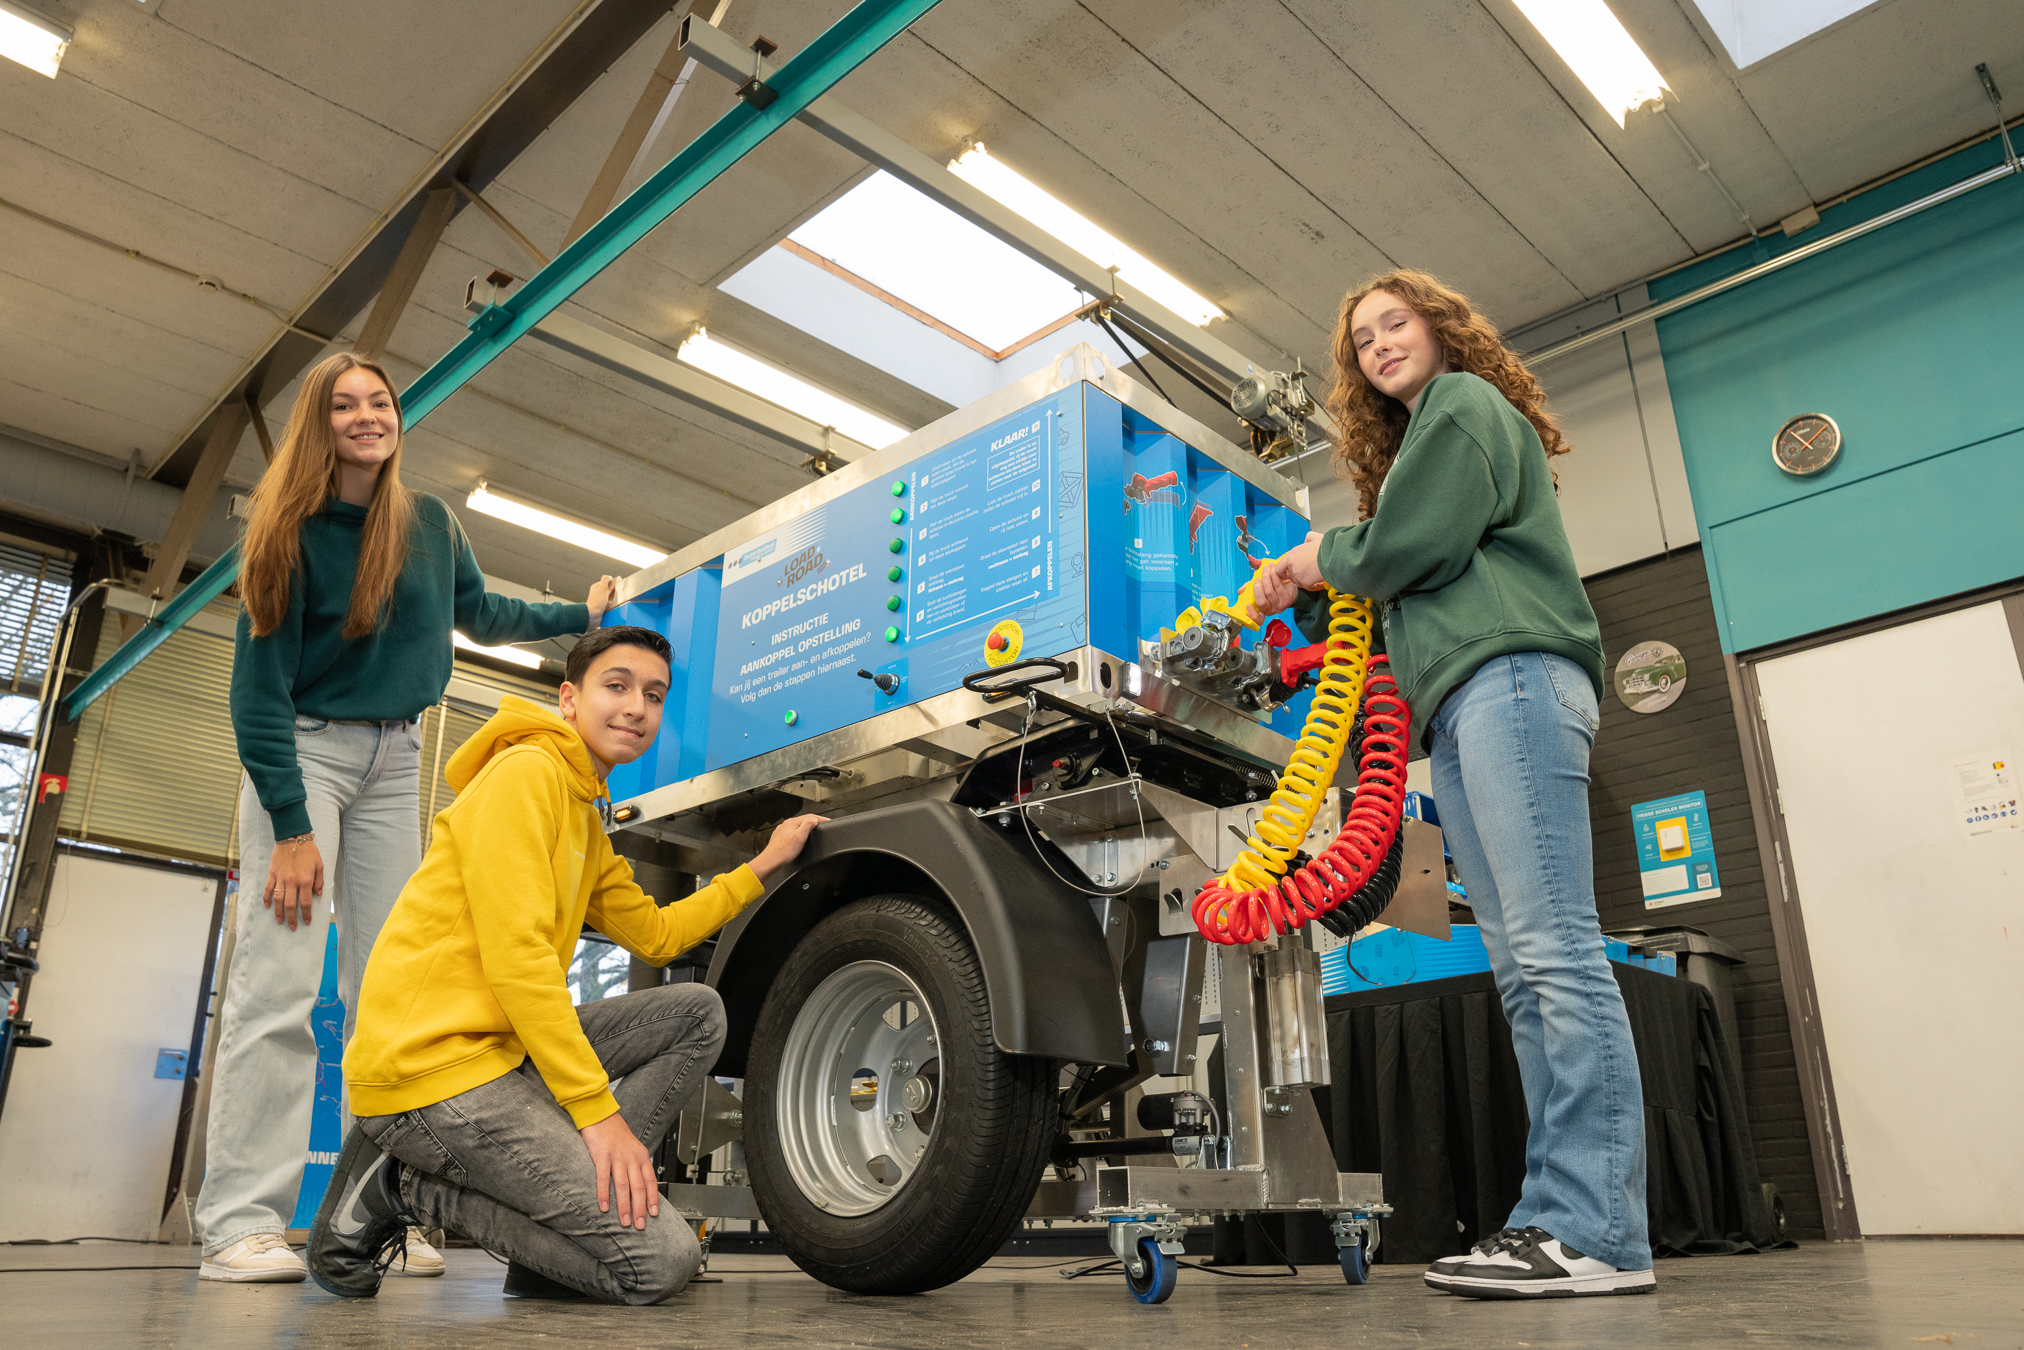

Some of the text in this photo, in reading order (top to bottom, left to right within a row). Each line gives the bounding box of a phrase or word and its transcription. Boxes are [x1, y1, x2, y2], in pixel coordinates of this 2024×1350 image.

[991, 426, 1029, 452] KLAAR!
[1007, 515, 1022, 524] schotel
[784, 546, 816, 576] LOAD
[786, 553, 823, 588] ROAD
[742, 562, 867, 629] KOPPELSCHOTEL
[771, 612, 829, 645] INSTRUCTIE
[730, 682, 742, 695] Kan
[752, 675, 766, 686] een
[768, 665, 789, 680] trailer
[791, 660, 809, 671] aan-
[810, 654, 820, 664] en
[822, 632, 871, 660] afkoppelen?
[740, 618, 861, 676] AANKOPPEL OPSTELLING
[740, 653, 856, 704] Volg dan de stappen hiernaast.
[1637, 810, 1654, 818] FRISSE
[1655, 806, 1677, 815] SCHOLEN
[1679, 801, 1701, 810] MONITOR
[903, 926, 930, 958] Vanco
